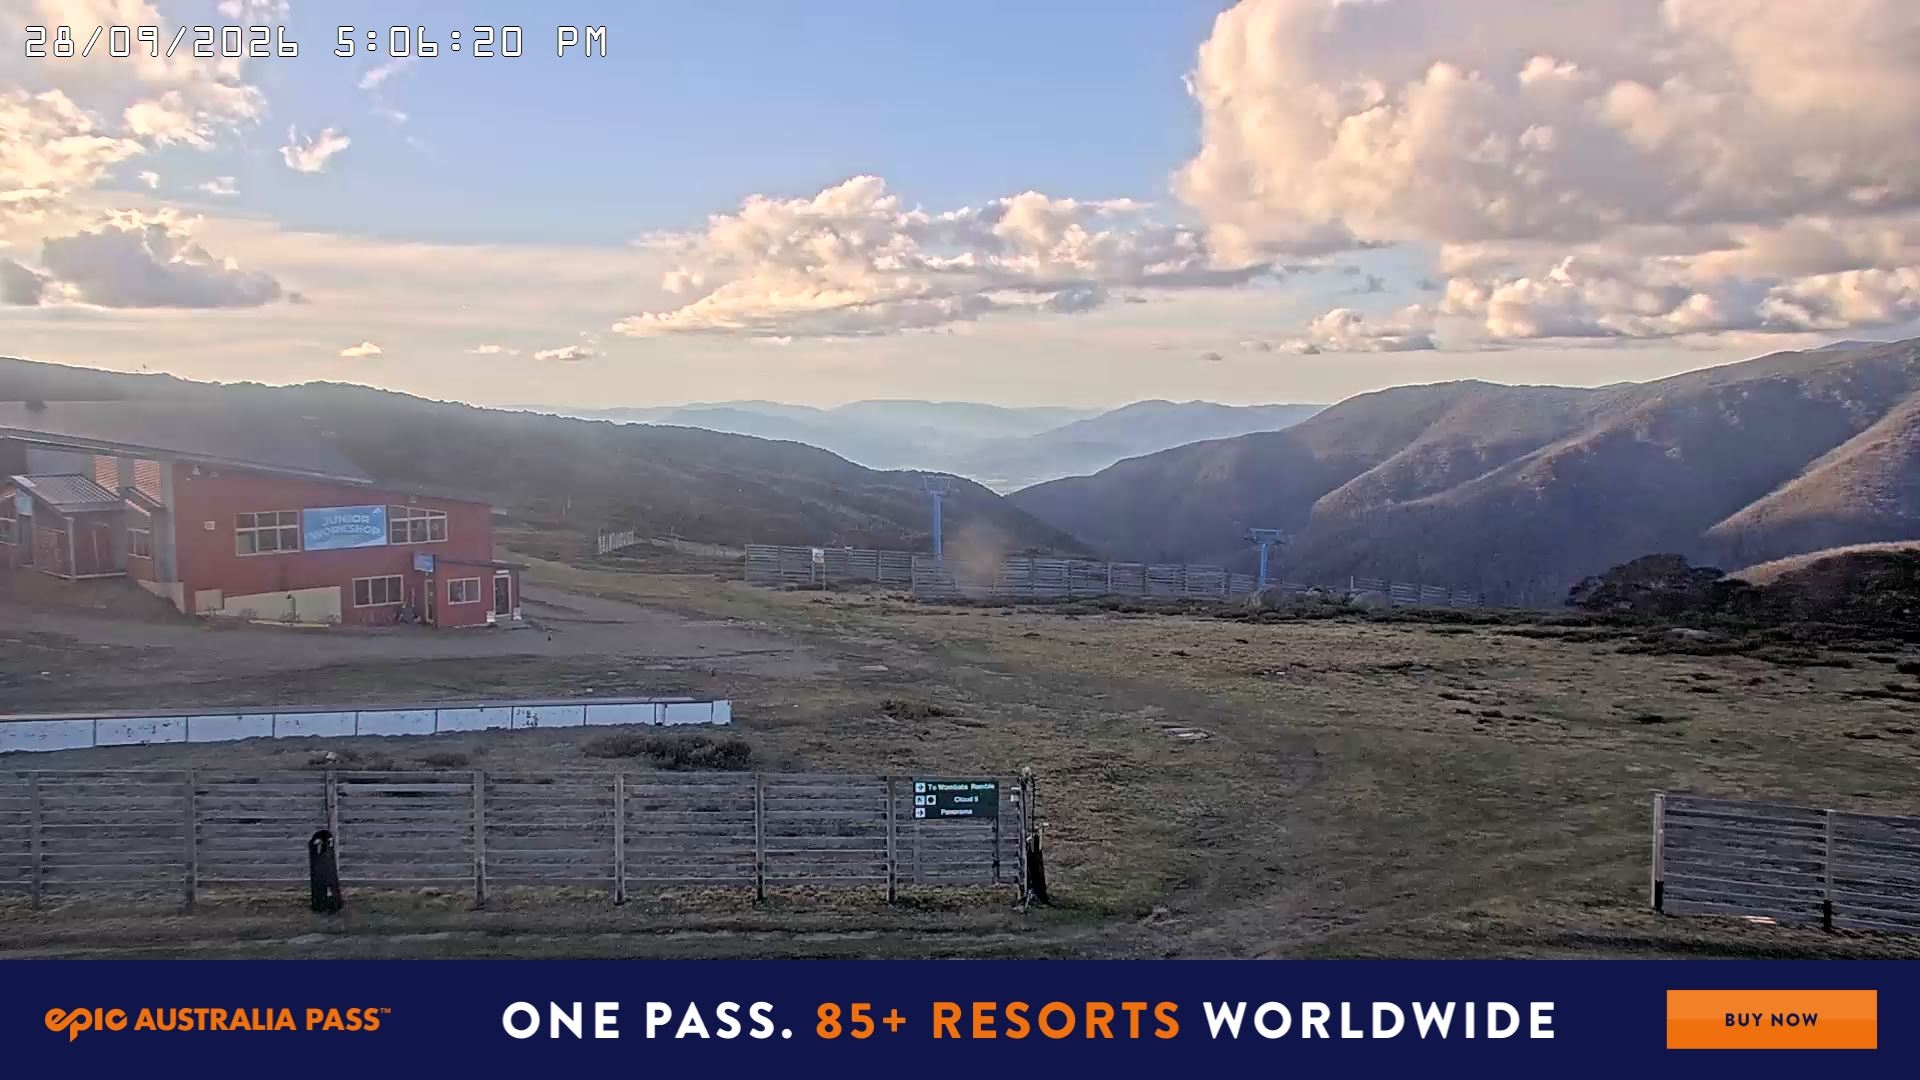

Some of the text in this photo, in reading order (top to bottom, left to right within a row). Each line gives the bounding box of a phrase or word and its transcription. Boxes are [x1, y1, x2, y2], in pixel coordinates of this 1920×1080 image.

[321, 514, 370, 527] JUNIOR
[306, 524, 381, 539] WORKSHOP
[927, 783, 937, 791] To
